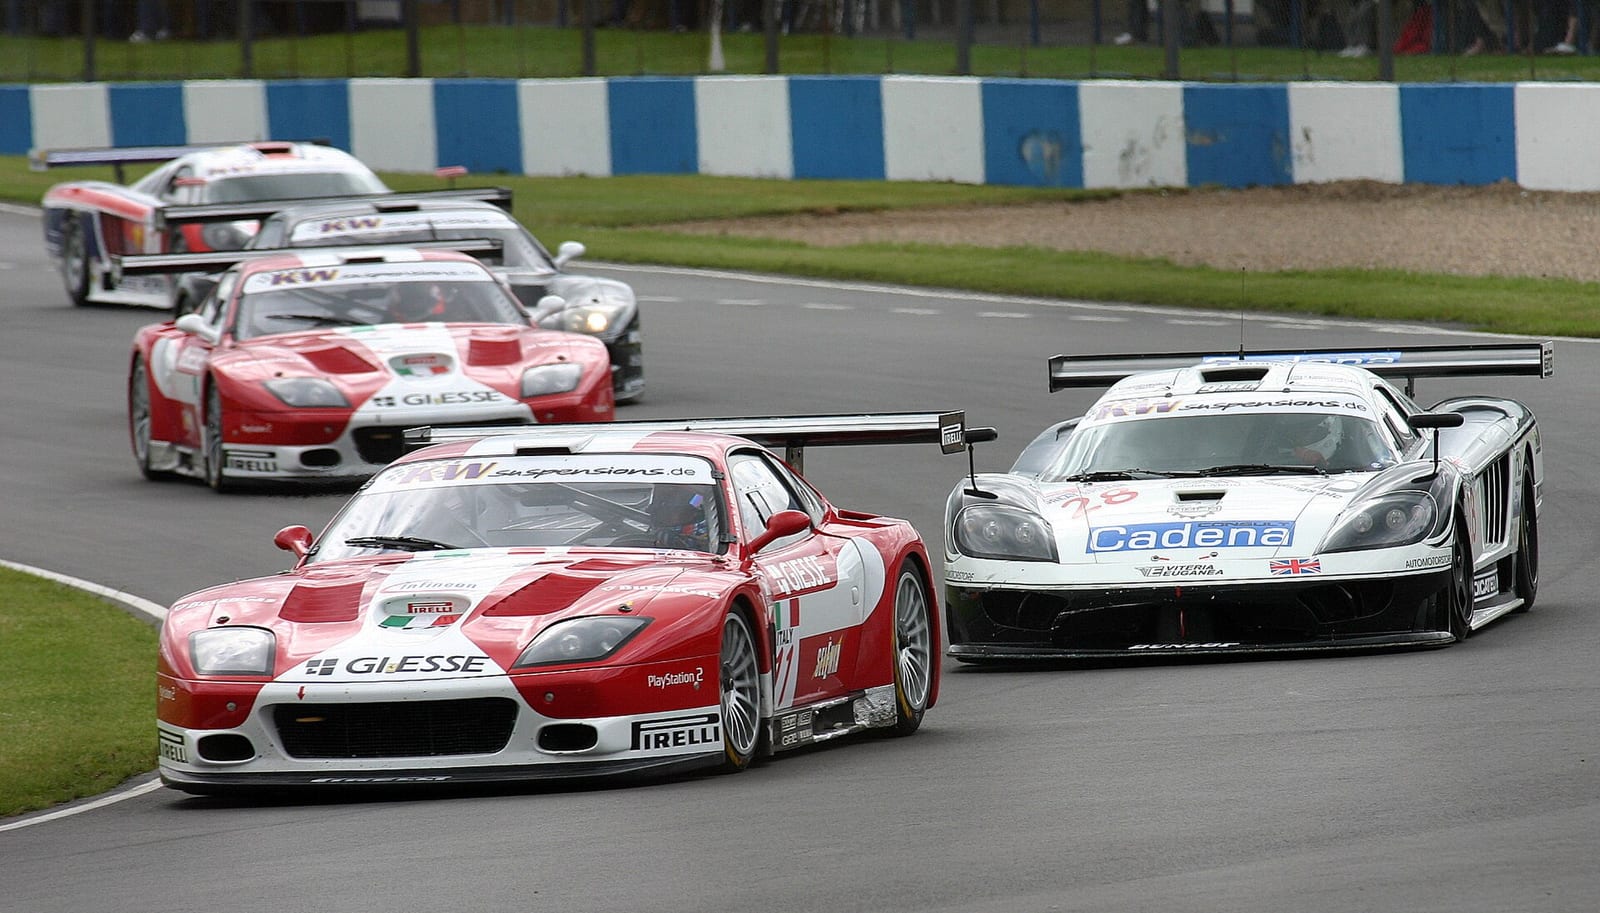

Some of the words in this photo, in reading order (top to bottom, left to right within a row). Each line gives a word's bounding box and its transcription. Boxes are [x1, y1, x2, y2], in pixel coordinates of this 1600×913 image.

[321, 219, 382, 232] KW
[271, 270, 339, 285] KW
[403, 391, 499, 406] GIESSE
[1179, 399, 1367, 412] suspensions.de
[942, 423, 962, 446] PIRELLI
[399, 462, 497, 483] KW
[488, 465, 696, 479] suspensions.de
[1061, 487, 1139, 519] 28
[1090, 523, 1290, 551] Cadena
[779, 555, 831, 591] GIESSE
[1162, 569, 1224, 577] EUGANEA
[407, 601, 453, 613] PIRELLI
[776, 628, 794, 646] ITALY
[346, 655, 491, 674] GIESSE
[647, 672, 695, 689] PlayStation
[695, 667, 704, 681] 2
[630, 712, 720, 751] PIRELLI
